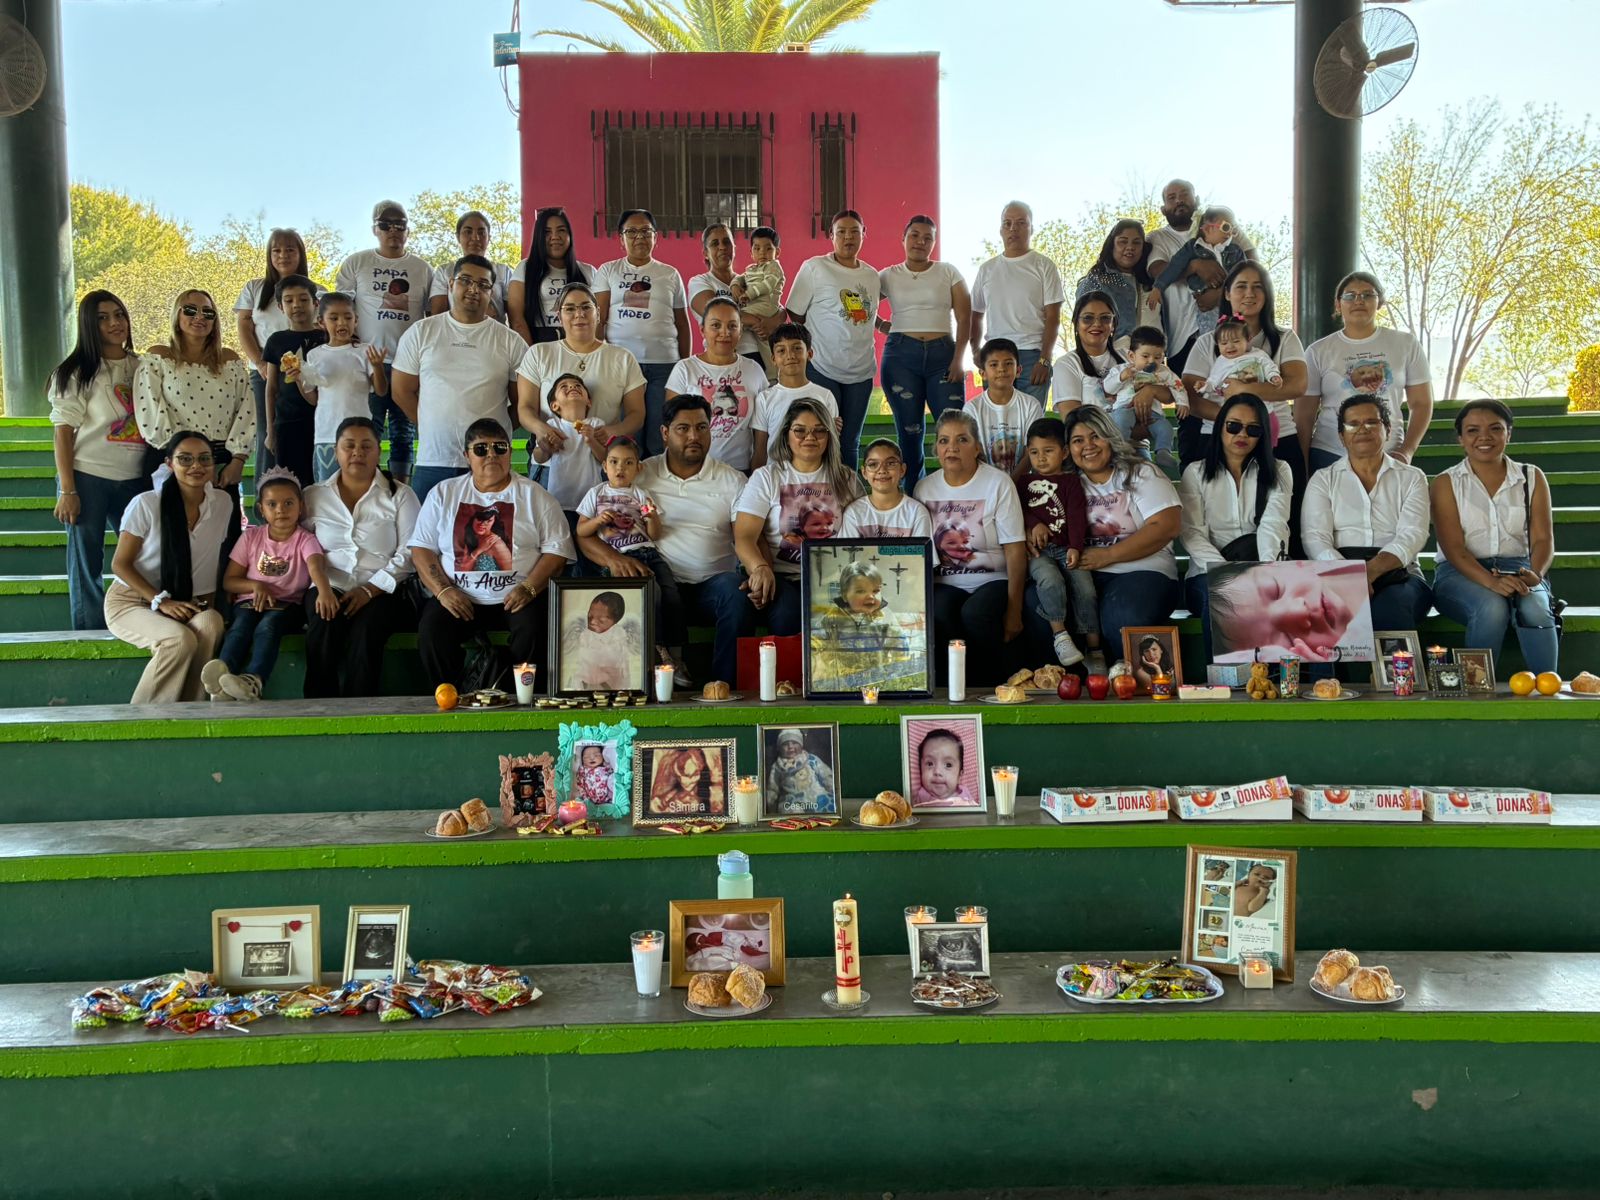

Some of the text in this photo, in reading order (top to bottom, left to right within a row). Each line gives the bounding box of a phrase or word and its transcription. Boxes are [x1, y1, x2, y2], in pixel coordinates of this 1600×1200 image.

[373, 280, 388, 291] DE
[619, 281, 631, 289] DE
[377, 310, 410, 321] TADEO
[617, 309, 651, 320] TADEO
[454, 573, 469, 589] Mi
[1236, 784, 1273, 804] DONAS
[669, 801, 706, 812] Samara
[783, 801, 819, 811] Cesarito
[1117, 795, 1152, 810] DONAS
[1377, 794, 1405, 808] ONAS
[1496, 797, 1533, 812] DONAS
